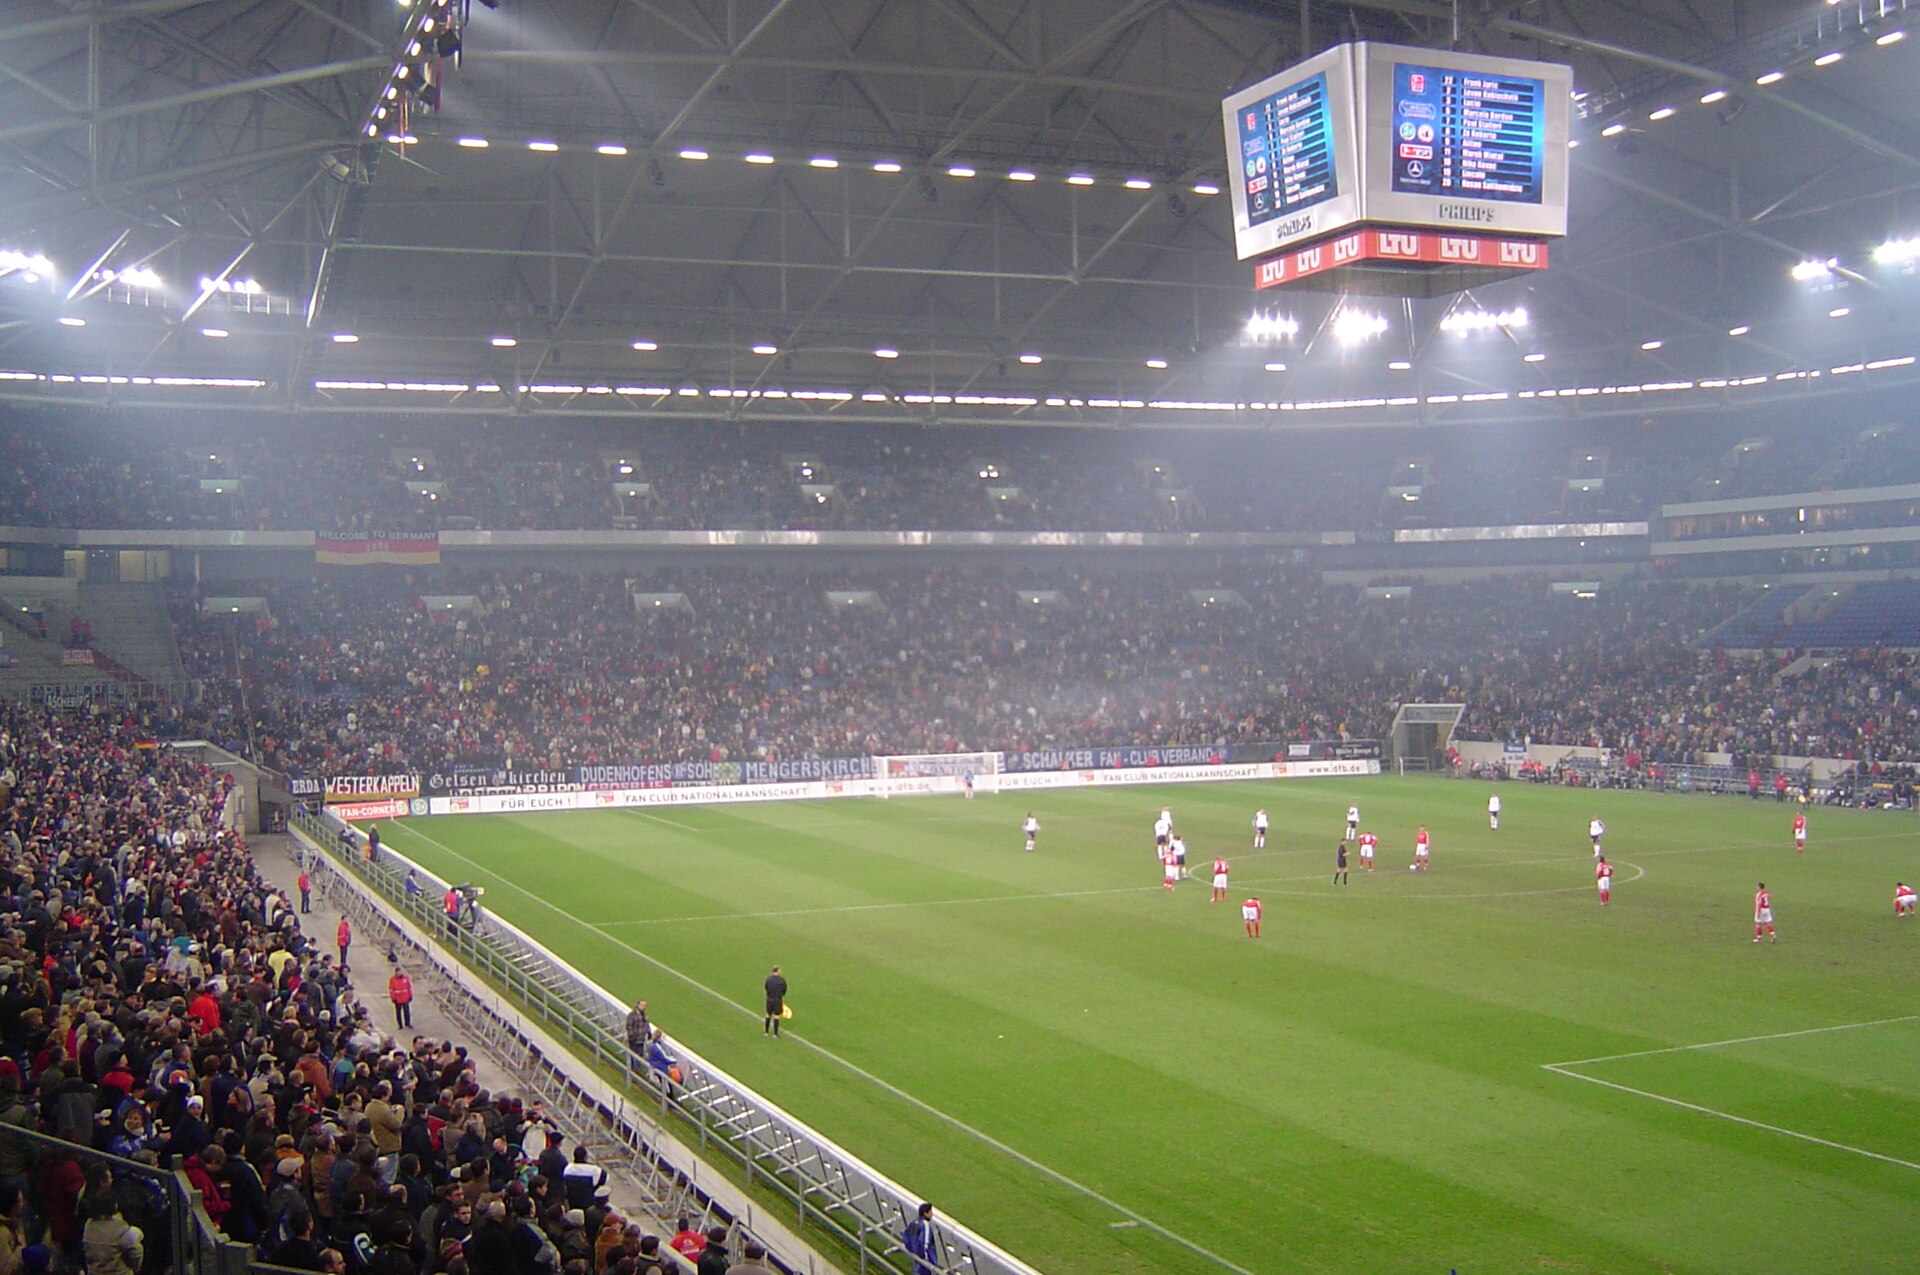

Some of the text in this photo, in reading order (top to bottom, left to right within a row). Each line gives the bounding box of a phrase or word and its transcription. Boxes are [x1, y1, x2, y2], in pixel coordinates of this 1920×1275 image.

[1439, 204, 1496, 222] PHILIPS
[1333, 235, 1359, 261] LTU
[1378, 233, 1418, 255] LTU
[1440, 237, 1478, 259] LTU
[1500, 241, 1537, 263] LTU
[1297, 247, 1320, 272] LTU
[1262, 259, 1285, 283] LTU
[373, 530, 385, 538] TO
[1161, 747, 1214, 764] VERBAND
[323, 775, 420, 794] WESTERKAPPELN
[500, 798, 525, 809] FÜR
[530, 798, 563, 808] EUCH
[625, 787, 808, 803] FAN CLUB NATIONALMANNSCHAFT
[341, 803, 397, 818] FAN-CORNER
